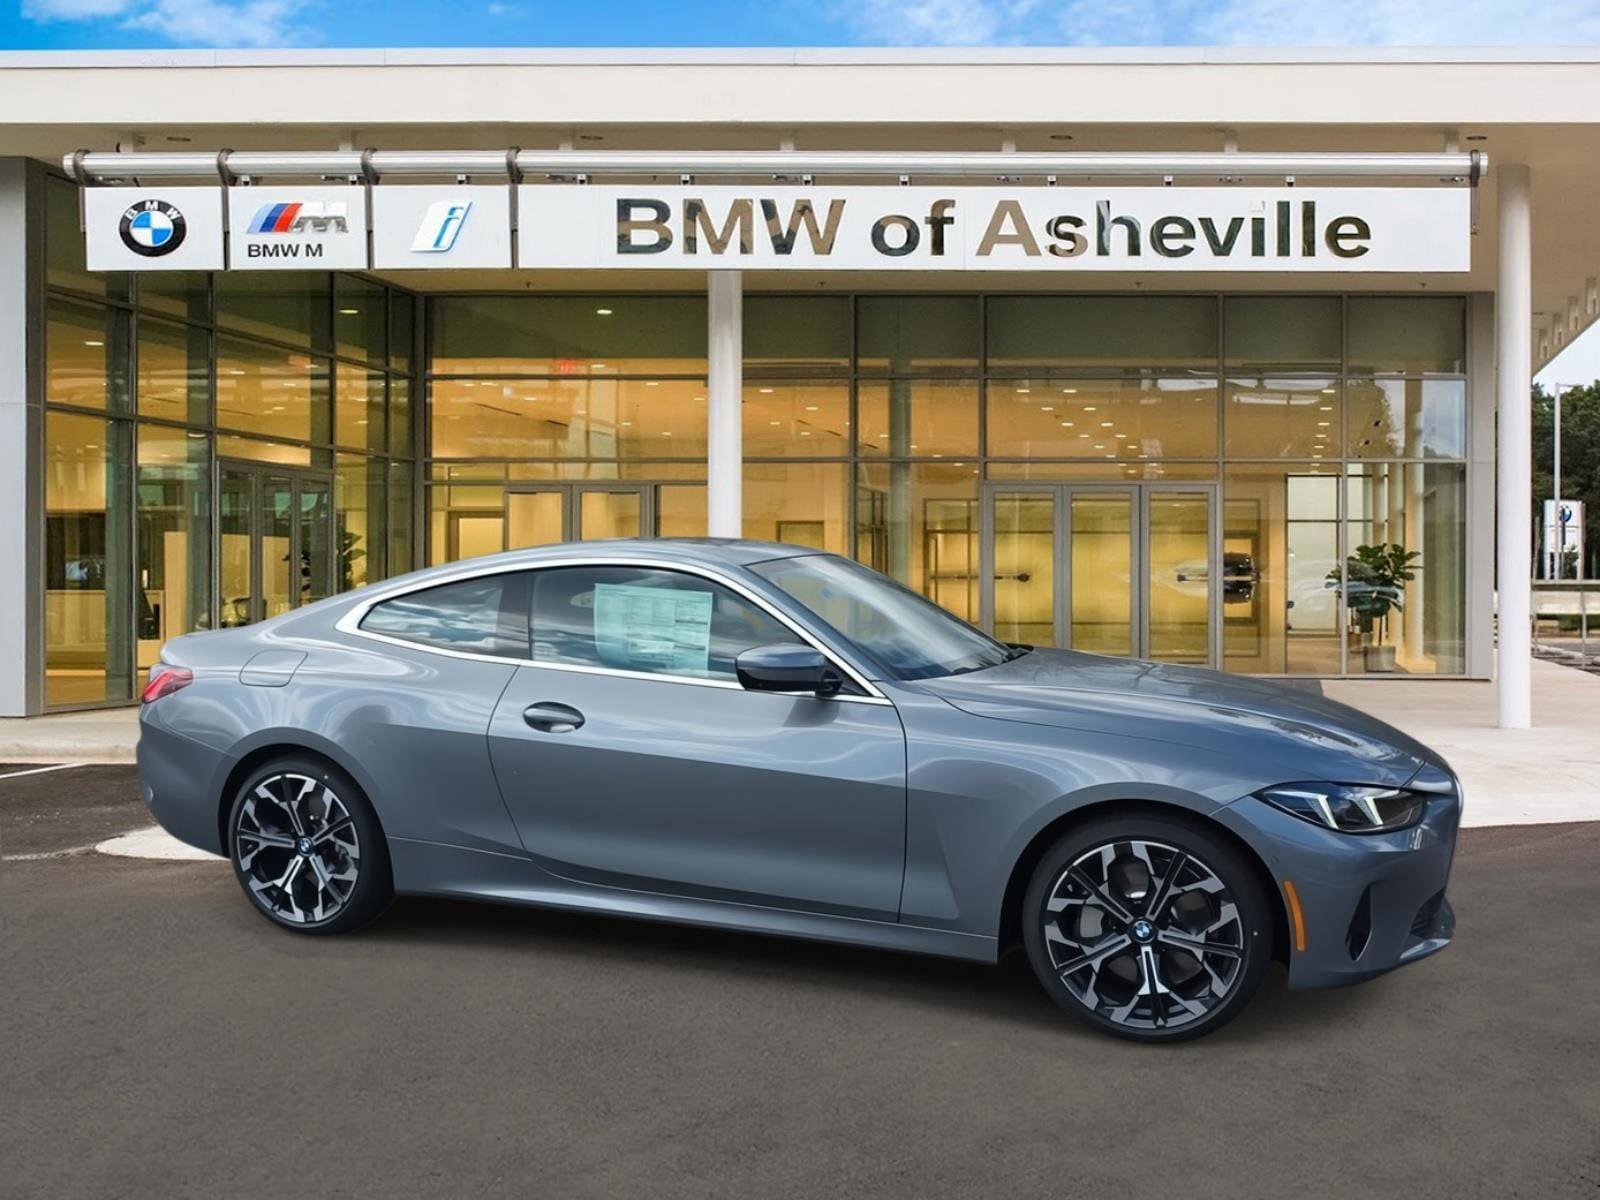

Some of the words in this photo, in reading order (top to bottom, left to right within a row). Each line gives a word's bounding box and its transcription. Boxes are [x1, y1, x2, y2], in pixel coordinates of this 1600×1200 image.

[125, 200, 181, 219] BMW
[616, 198, 846, 255] BMW
[871, 199, 956, 257] of
[975, 199, 1371, 258] Asheville
[247, 243, 300, 258] BMW
[305, 243, 323, 257] M
